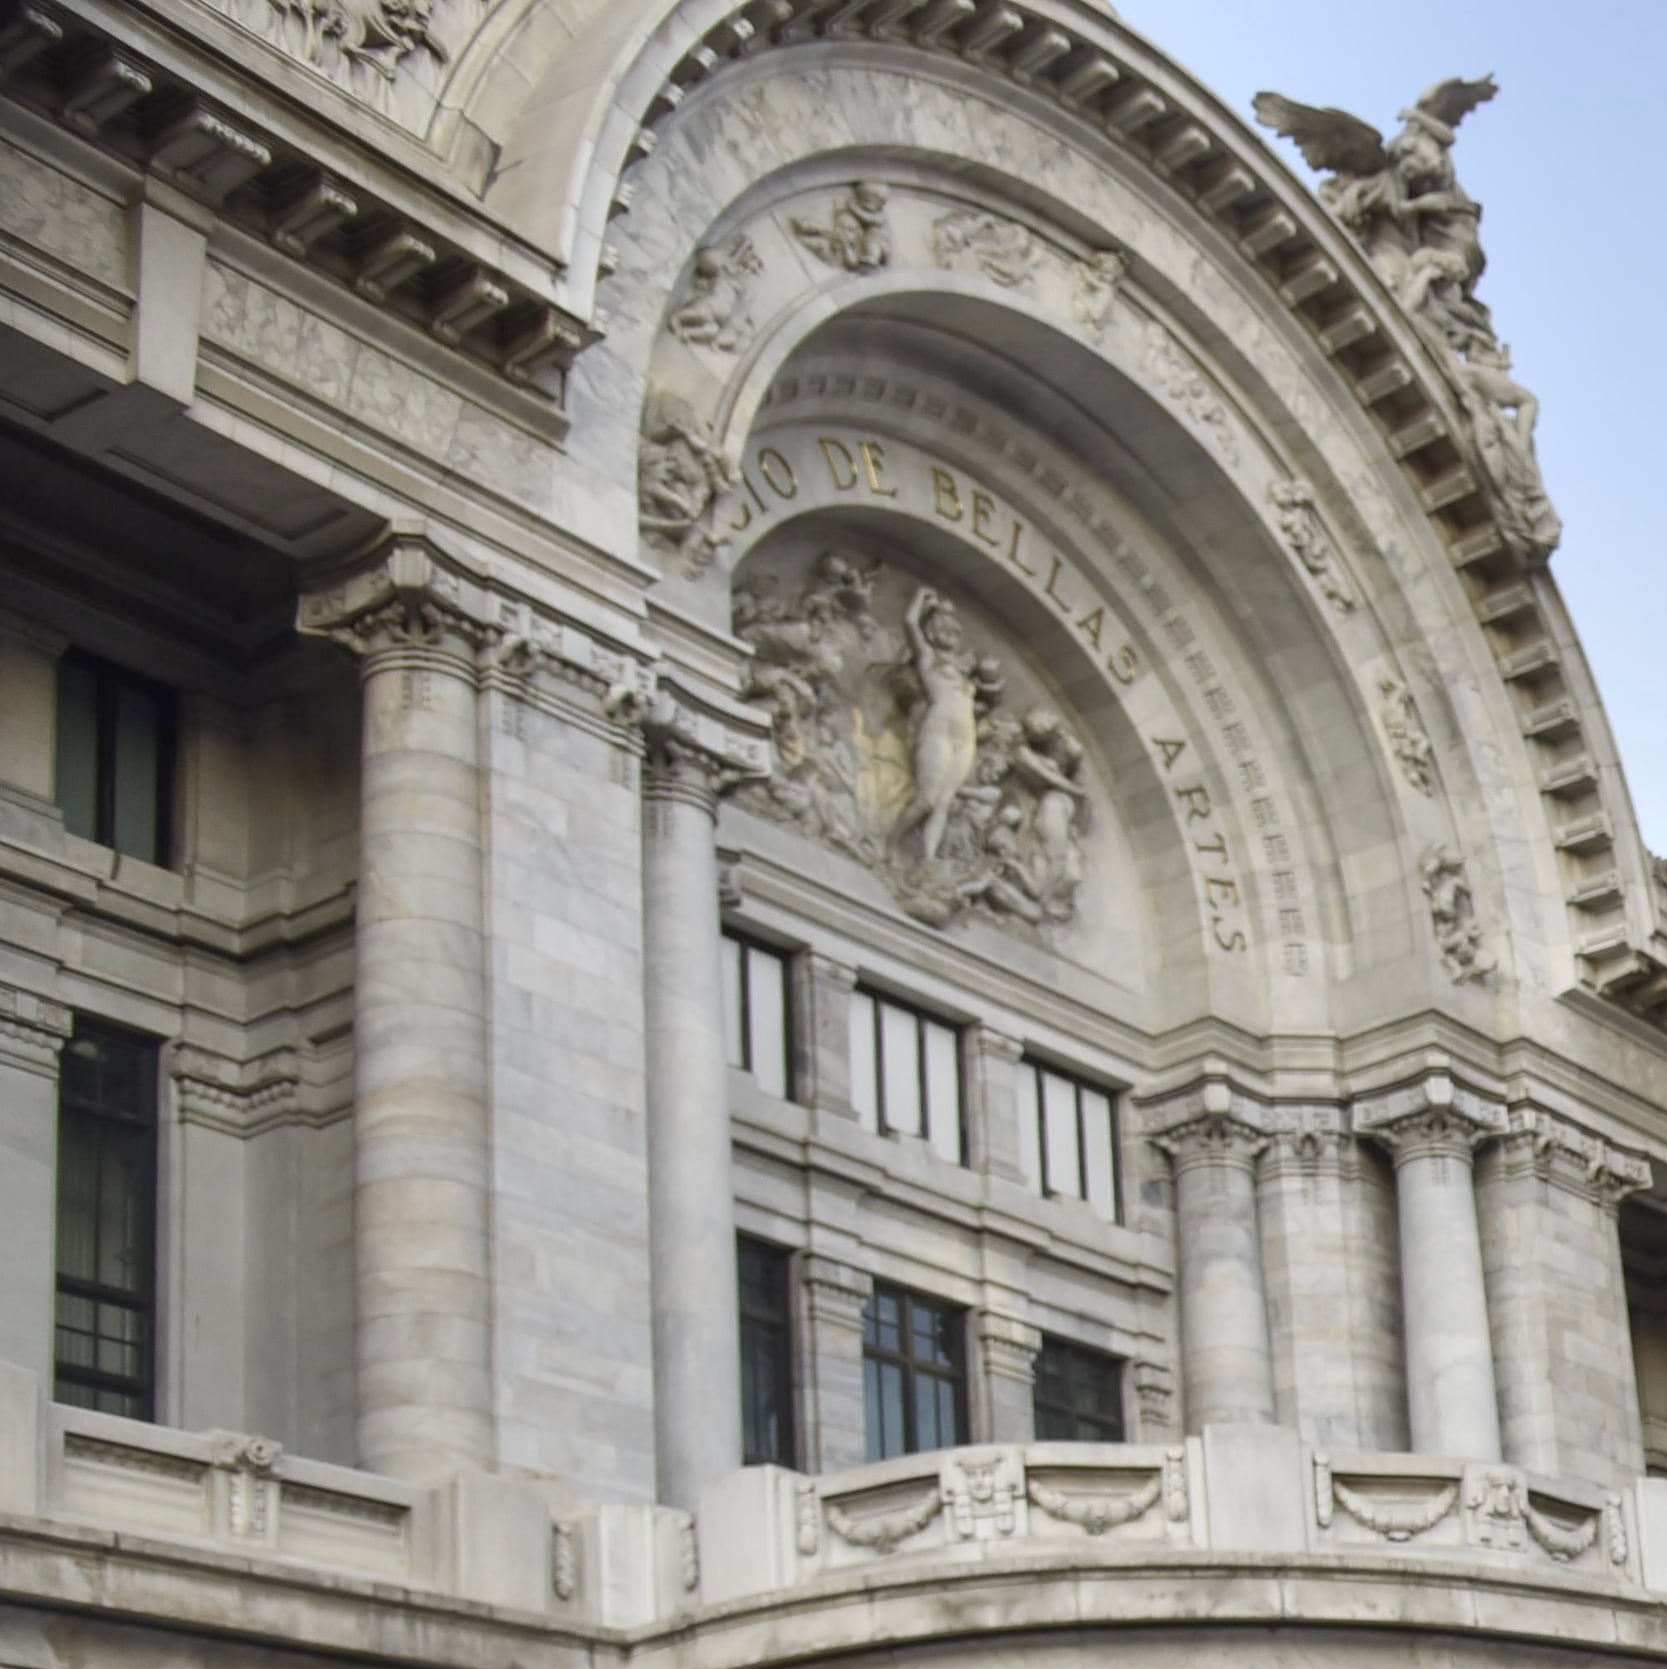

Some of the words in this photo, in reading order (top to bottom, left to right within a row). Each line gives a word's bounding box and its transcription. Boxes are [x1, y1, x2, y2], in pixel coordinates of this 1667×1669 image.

[818, 436, 897, 498] DE
[931, 466, 1140, 688] BELLAS
[1152, 736, 1247, 953] ARTES
